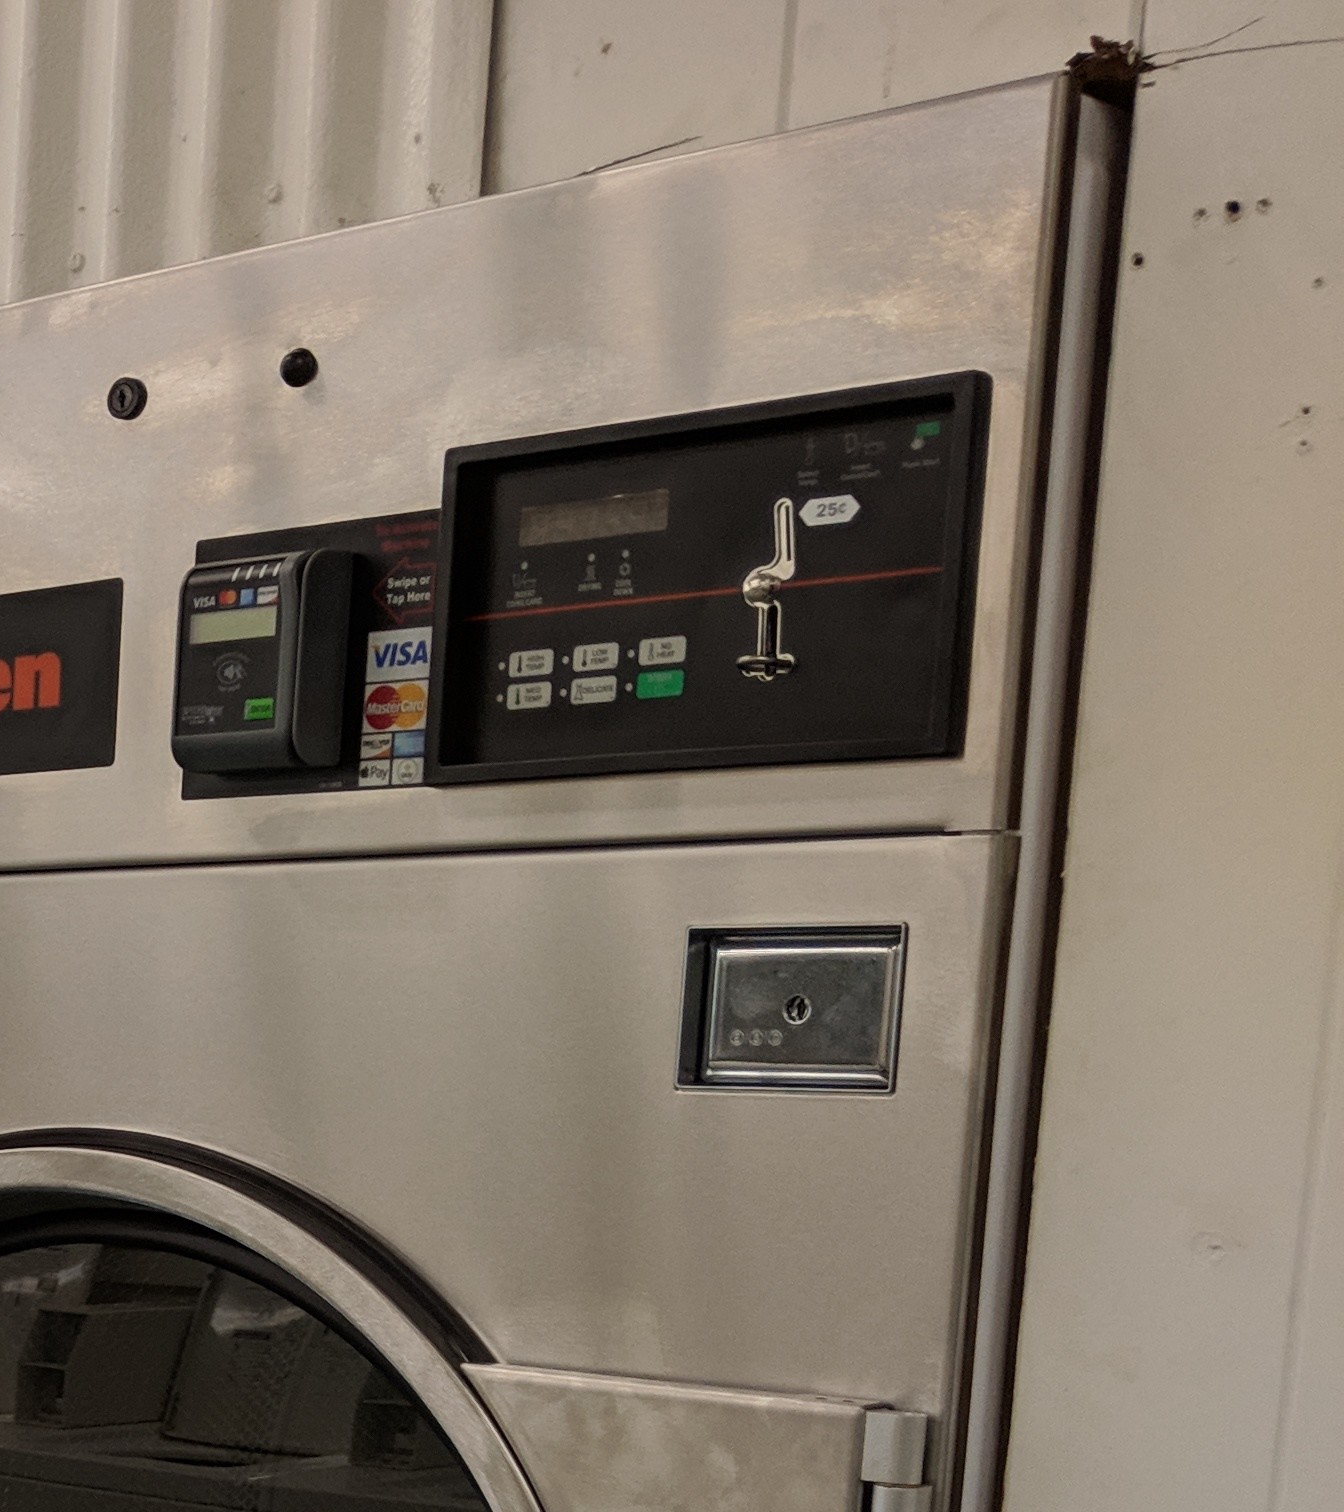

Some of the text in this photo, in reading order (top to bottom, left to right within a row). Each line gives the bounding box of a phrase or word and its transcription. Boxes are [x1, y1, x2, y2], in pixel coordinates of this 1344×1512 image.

[815, 502, 848, 518] 25¢
[387, 574, 431, 590] Swipe or
[193, 596, 216, 608] VISA
[386, 590, 431, 607] Tap Here
[371, 639, 429, 668] VISA
[366, 699, 427, 715] MasterCard
